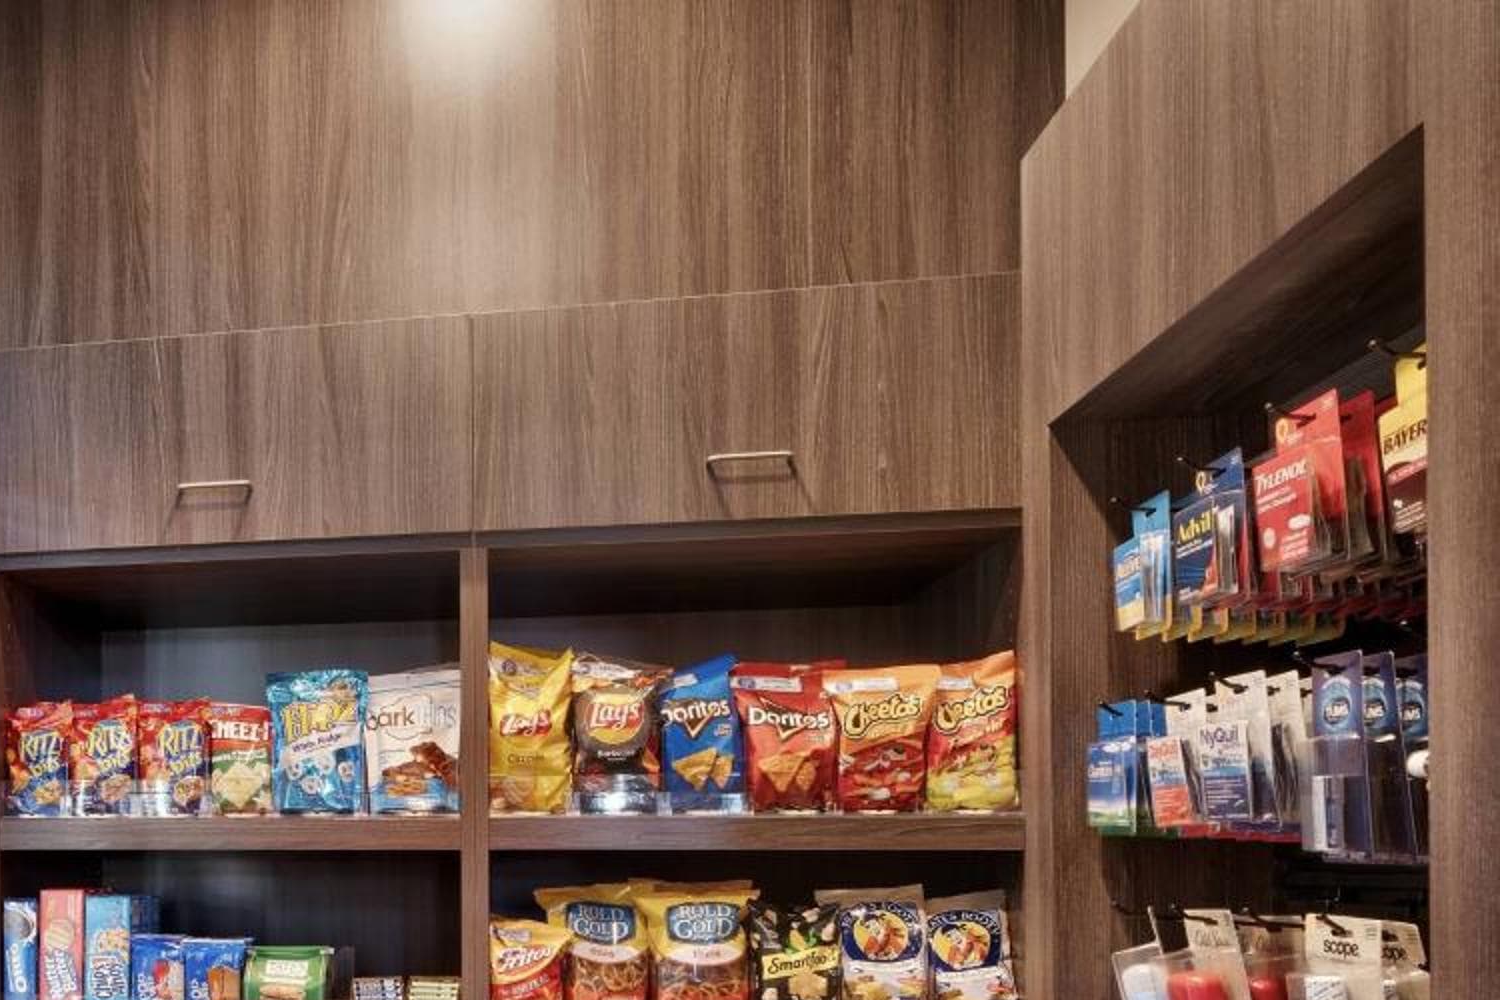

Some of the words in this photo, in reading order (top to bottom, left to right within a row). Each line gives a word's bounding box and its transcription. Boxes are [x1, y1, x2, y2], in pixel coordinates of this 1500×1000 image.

[1383, 420, 1427, 452] BAYER
[1255, 460, 1308, 493] TYLENOL
[1177, 512, 1214, 544] Advil
[589, 700, 642, 728] Lay's
[748, 706, 830, 729] Doritos
[845, 694, 922, 739] Cheetos
[935, 686, 1008, 733] Cheetos
[158, 721, 203, 752] RITZ
[502, 711, 550, 736] Lay's
[577, 905, 625, 920] ROLD
[677, 904, 734, 919] ROLD
[573, 918, 630, 938] GOLD
[674, 917, 734, 938] GOLD
[1323, 940, 1360, 959] scope
